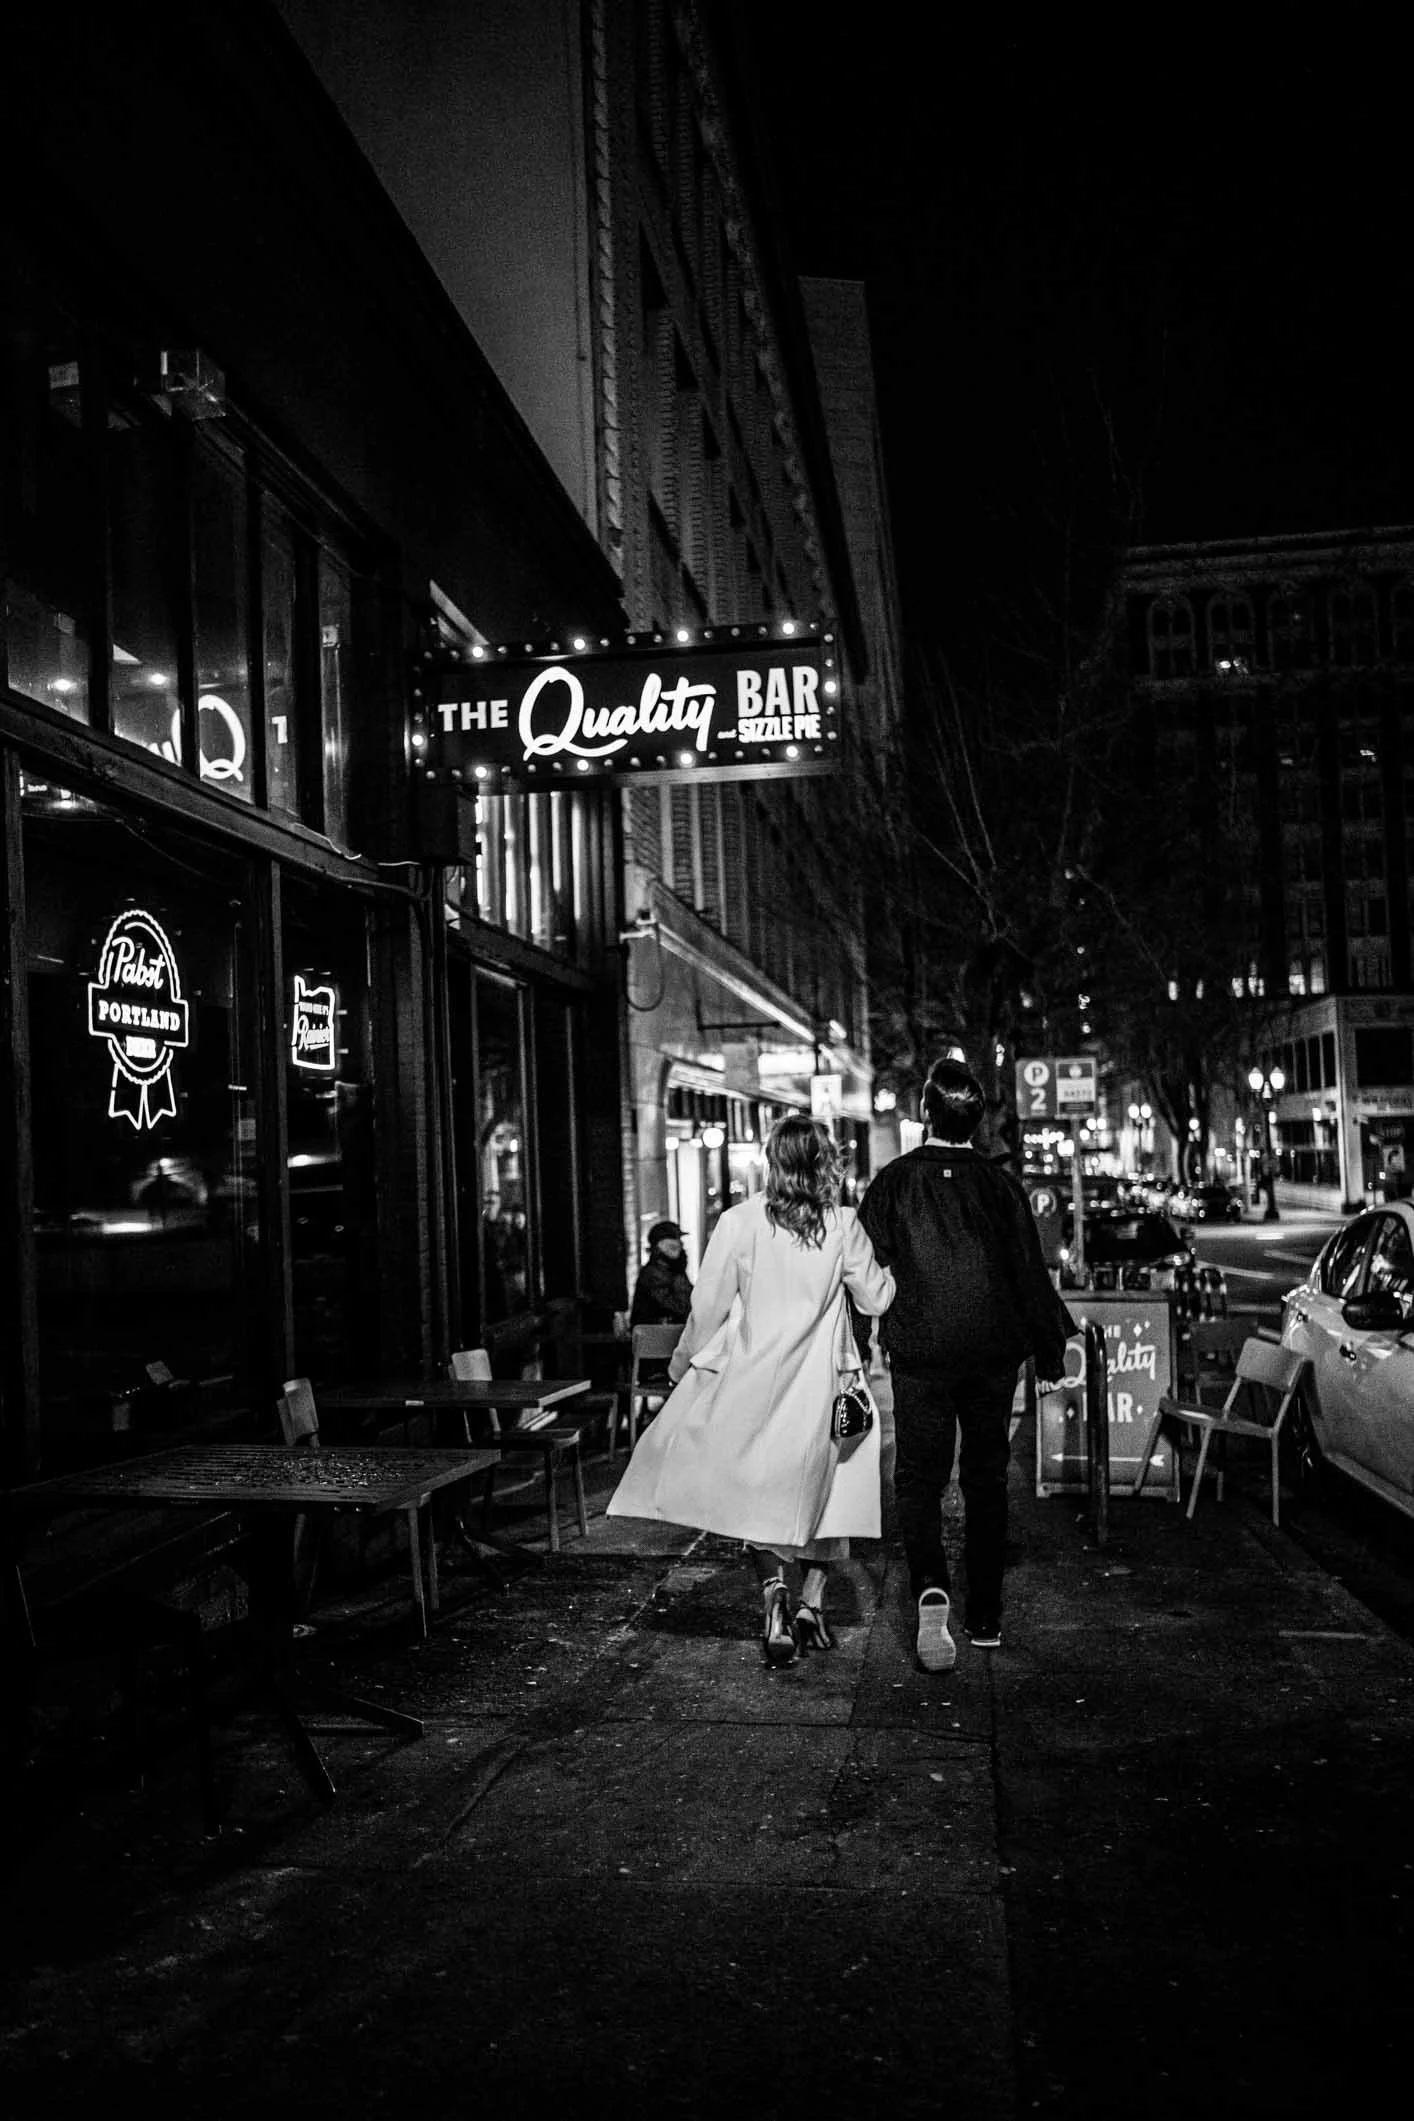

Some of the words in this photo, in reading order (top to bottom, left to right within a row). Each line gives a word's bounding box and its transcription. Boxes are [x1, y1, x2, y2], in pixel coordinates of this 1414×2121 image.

[437, 699, 509, 733] THE
[518, 666, 717, 761] Quality
[736, 665, 820, 719] BAR
[738, 716, 793, 743] SIZZLE
[794, 714, 821, 739] PIE
[111, 936, 166, 990] Pabst
[98, 999, 181, 1032] PORTLAND
[1031, 1066, 1043, 1082] P
[1030, 1087, 1047, 1111] 2
